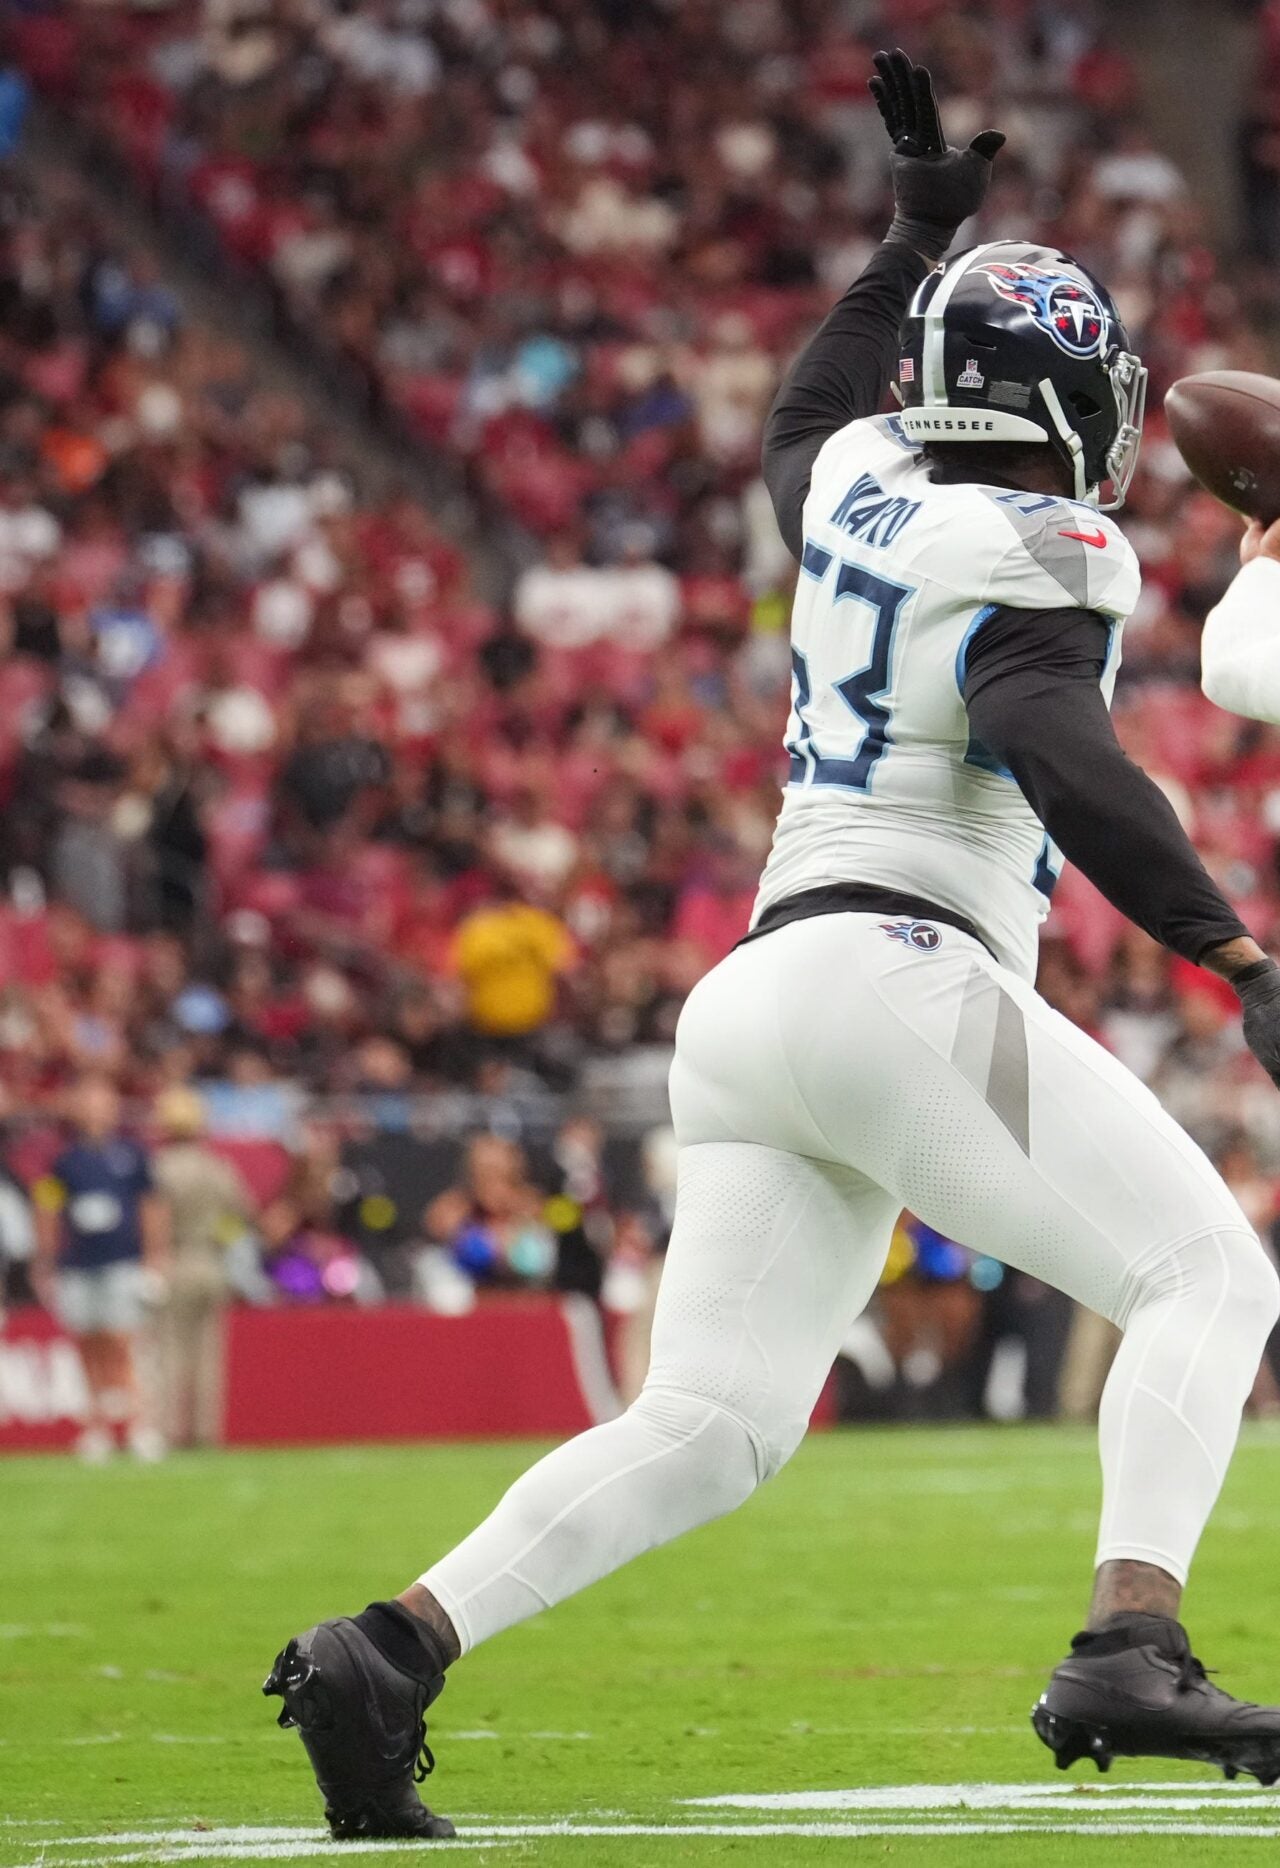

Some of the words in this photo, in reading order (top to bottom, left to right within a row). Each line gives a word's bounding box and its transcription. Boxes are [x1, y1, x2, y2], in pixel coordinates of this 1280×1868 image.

[959, 376, 983, 385] CATCH
[904, 420, 993, 431] TENNESSEE
[828, 471, 924, 547] WARD
